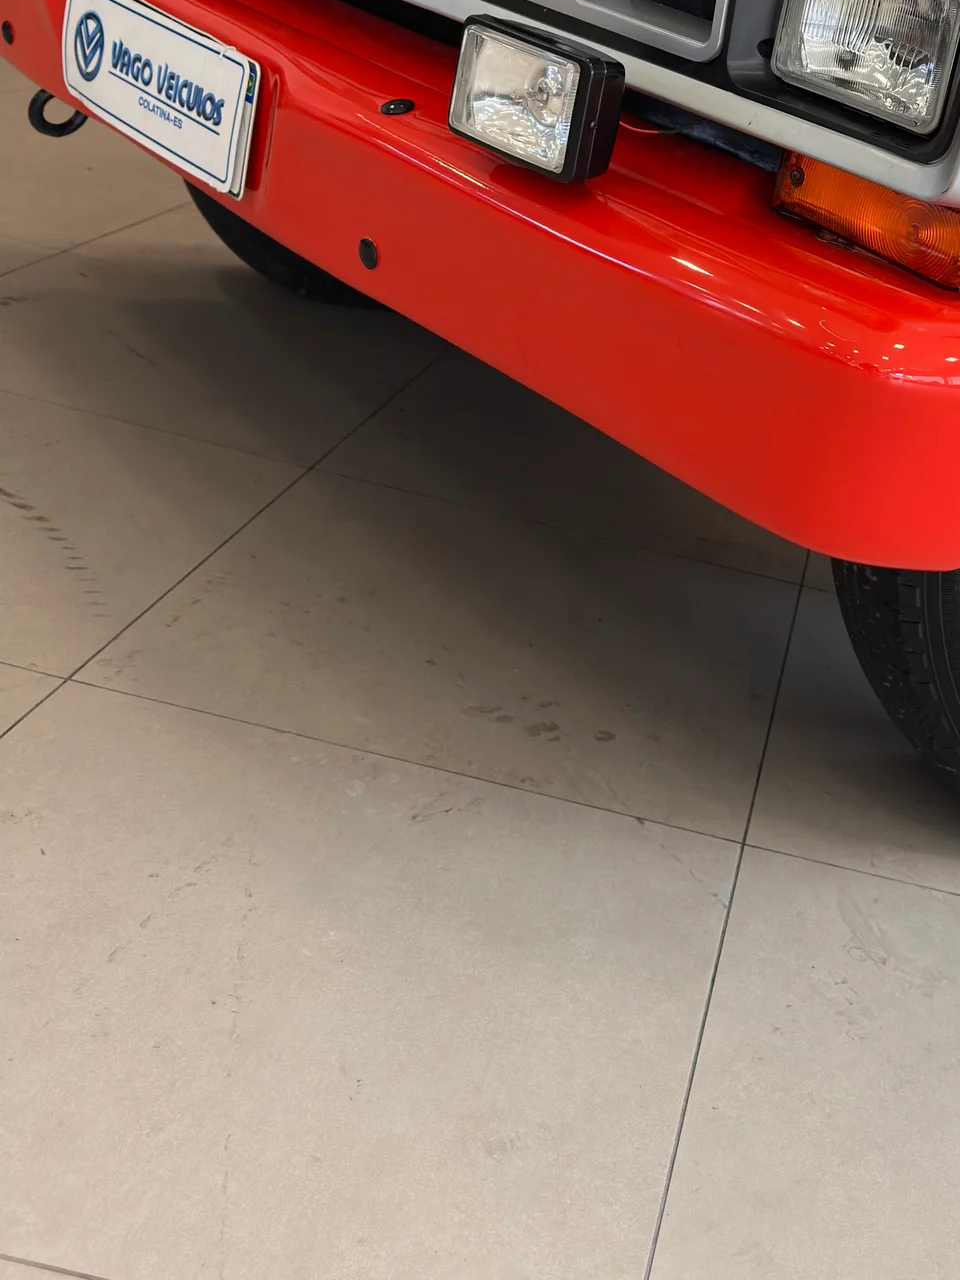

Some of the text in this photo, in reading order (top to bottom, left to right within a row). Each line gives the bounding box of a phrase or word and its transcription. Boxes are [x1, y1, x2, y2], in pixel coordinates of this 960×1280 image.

[111, 38, 225, 126] VAGO VEICULOS
[138, 96, 183, 129] COLATINA-ES
